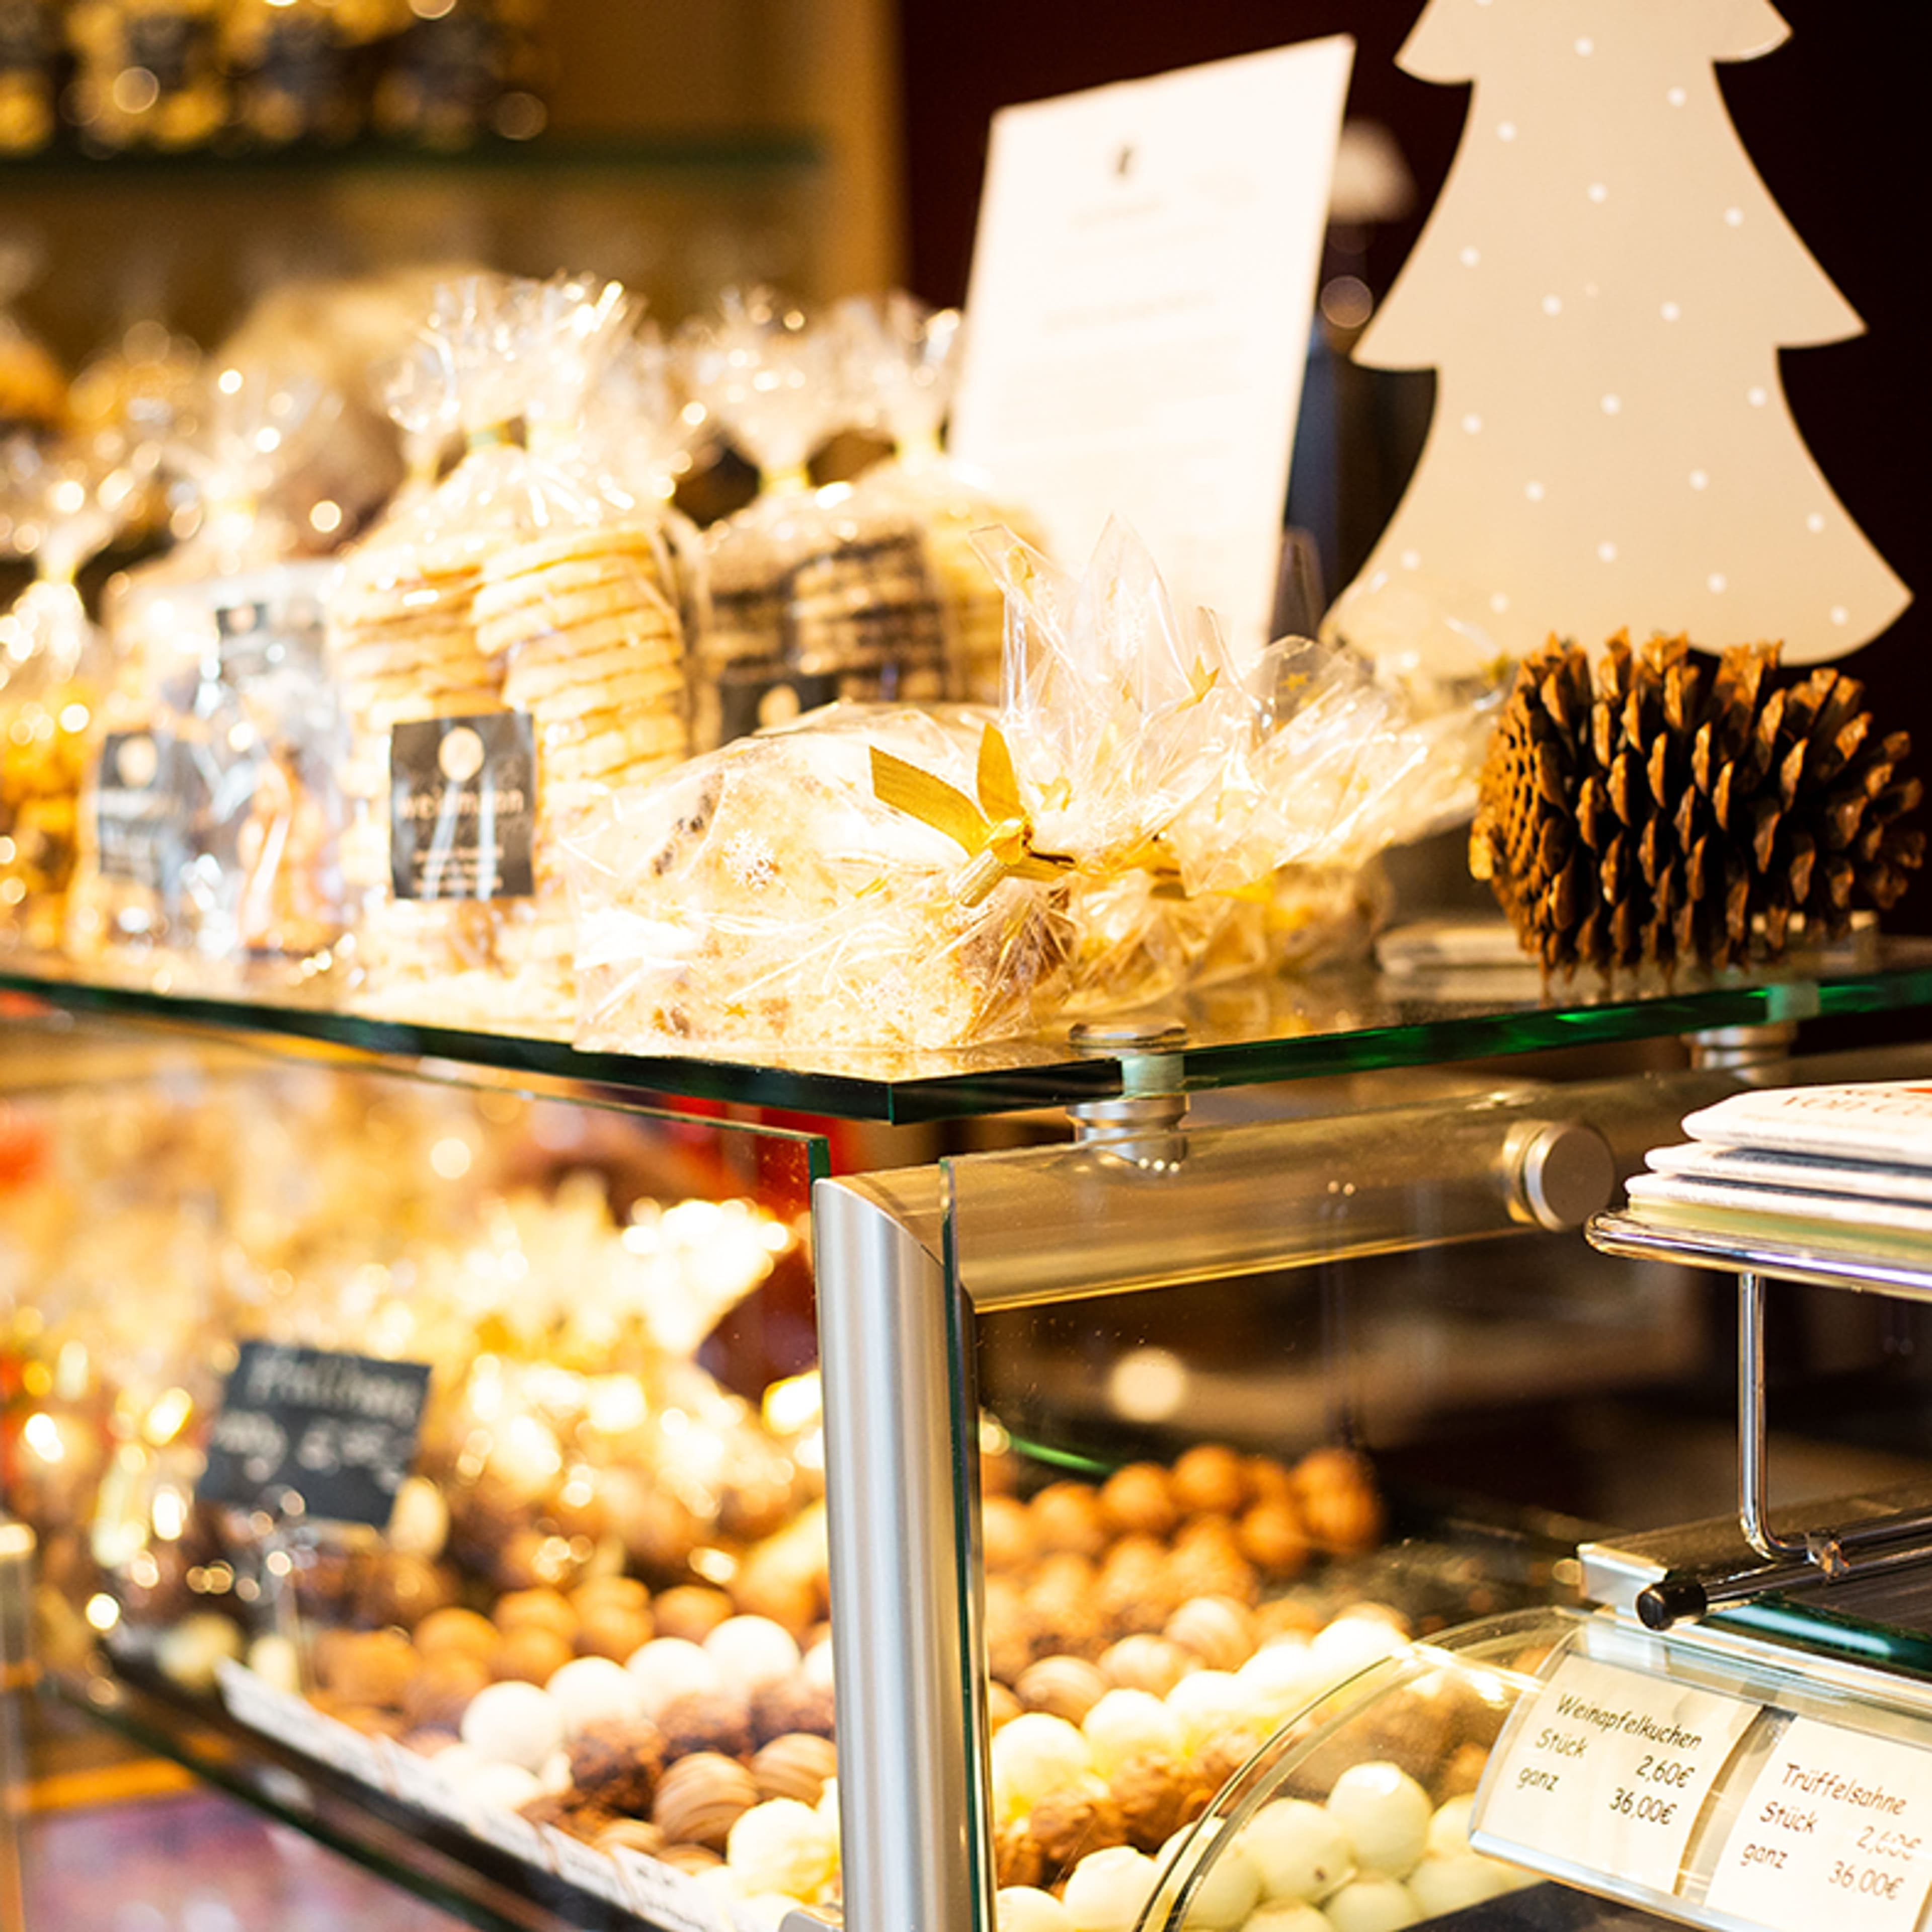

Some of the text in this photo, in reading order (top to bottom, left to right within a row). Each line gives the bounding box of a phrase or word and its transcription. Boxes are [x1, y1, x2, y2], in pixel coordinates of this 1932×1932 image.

[1556, 1694, 1702, 1751] Weinapfelkuchen
[1535, 1728, 1696, 1788] Stück 2,60€
[1516, 1766, 1678, 1825] ganz 36,00€
[1782, 1762, 1907, 1815] Trüffelsahne
[1759, 1800, 1818, 1834] Stück
[1740, 1843, 1788, 1869] ganz
